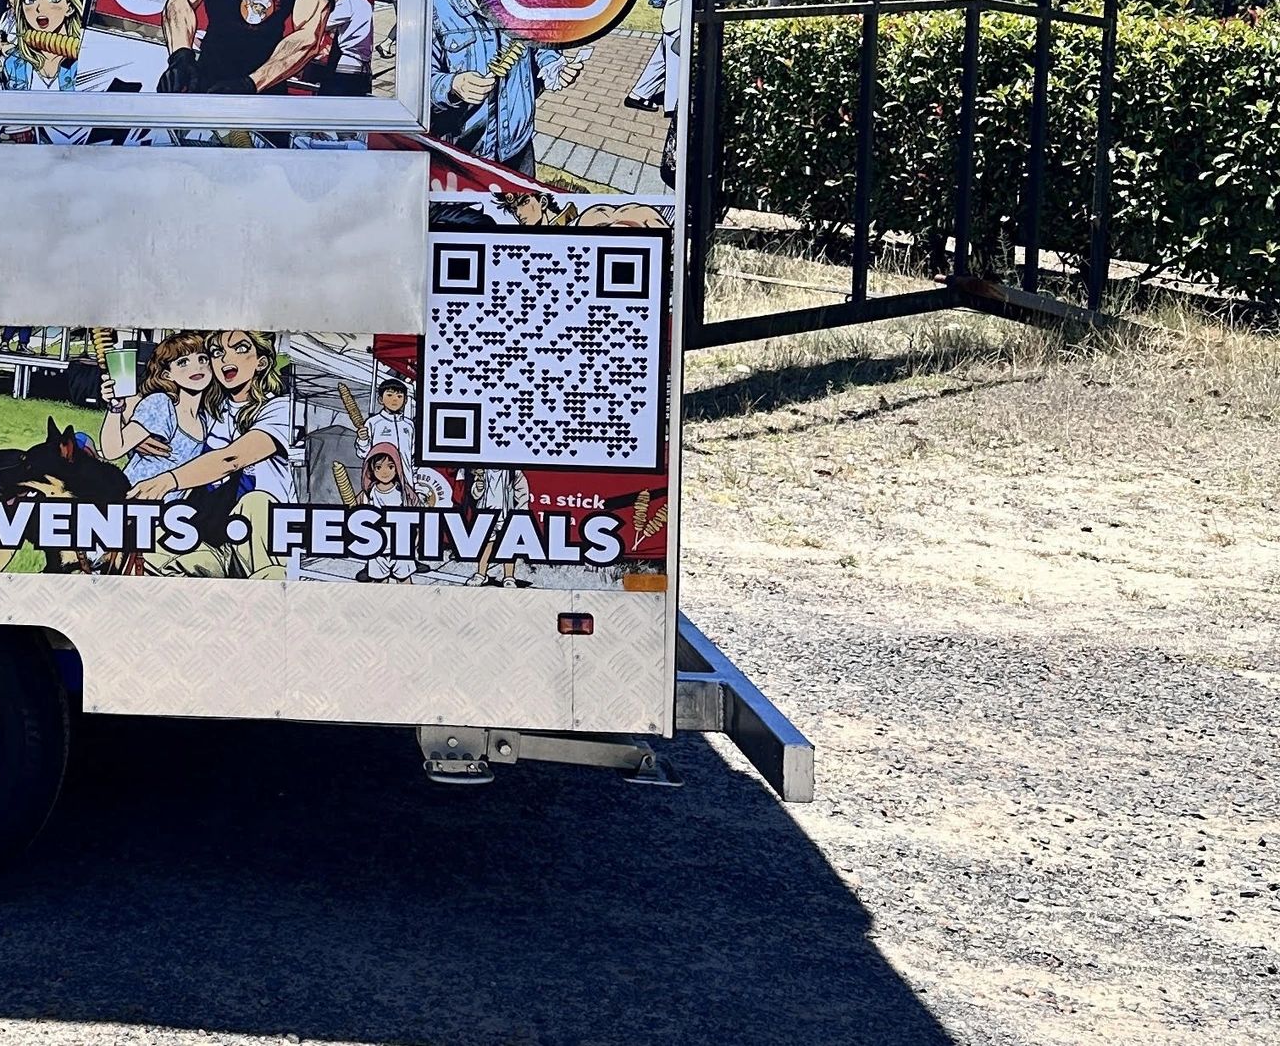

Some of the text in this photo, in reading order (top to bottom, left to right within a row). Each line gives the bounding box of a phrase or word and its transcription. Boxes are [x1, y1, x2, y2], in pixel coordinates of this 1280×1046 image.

[539, 492, 606, 510] a stick
[273, 508, 621, 563] FESTIVALS
